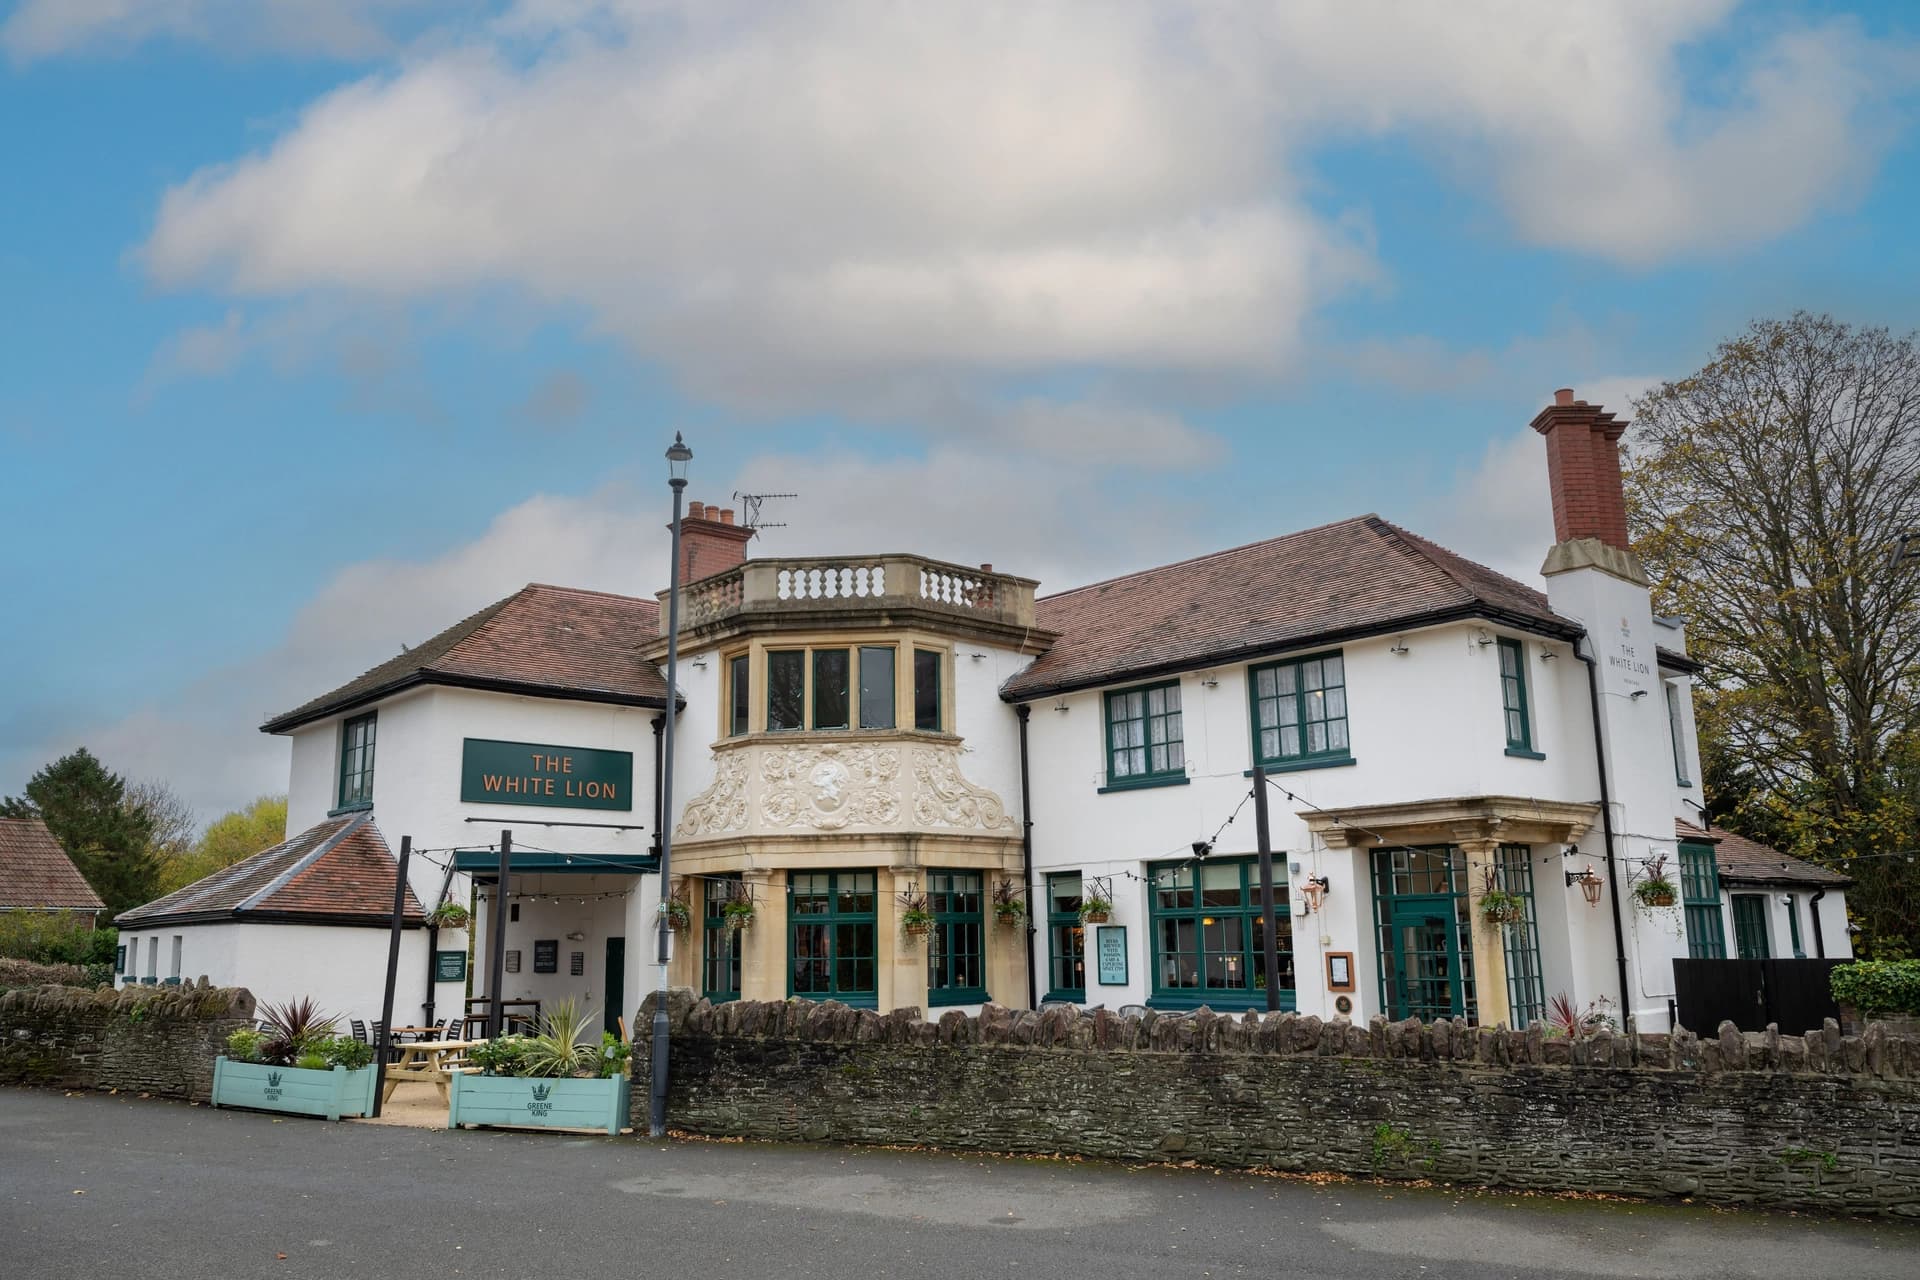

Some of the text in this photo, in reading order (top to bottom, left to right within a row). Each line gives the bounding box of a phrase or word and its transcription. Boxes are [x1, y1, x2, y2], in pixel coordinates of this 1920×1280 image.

[1621, 644, 1635, 657] THE
[1608, 655, 1650, 675] WHITE LION
[532, 754, 573, 773] THE
[483, 774, 616, 799] WHITE LION
[264, 1087, 282, 1095] GREENE
[527, 1102, 553, 1110] GREENE
[531, 1109, 548, 1117] KING
